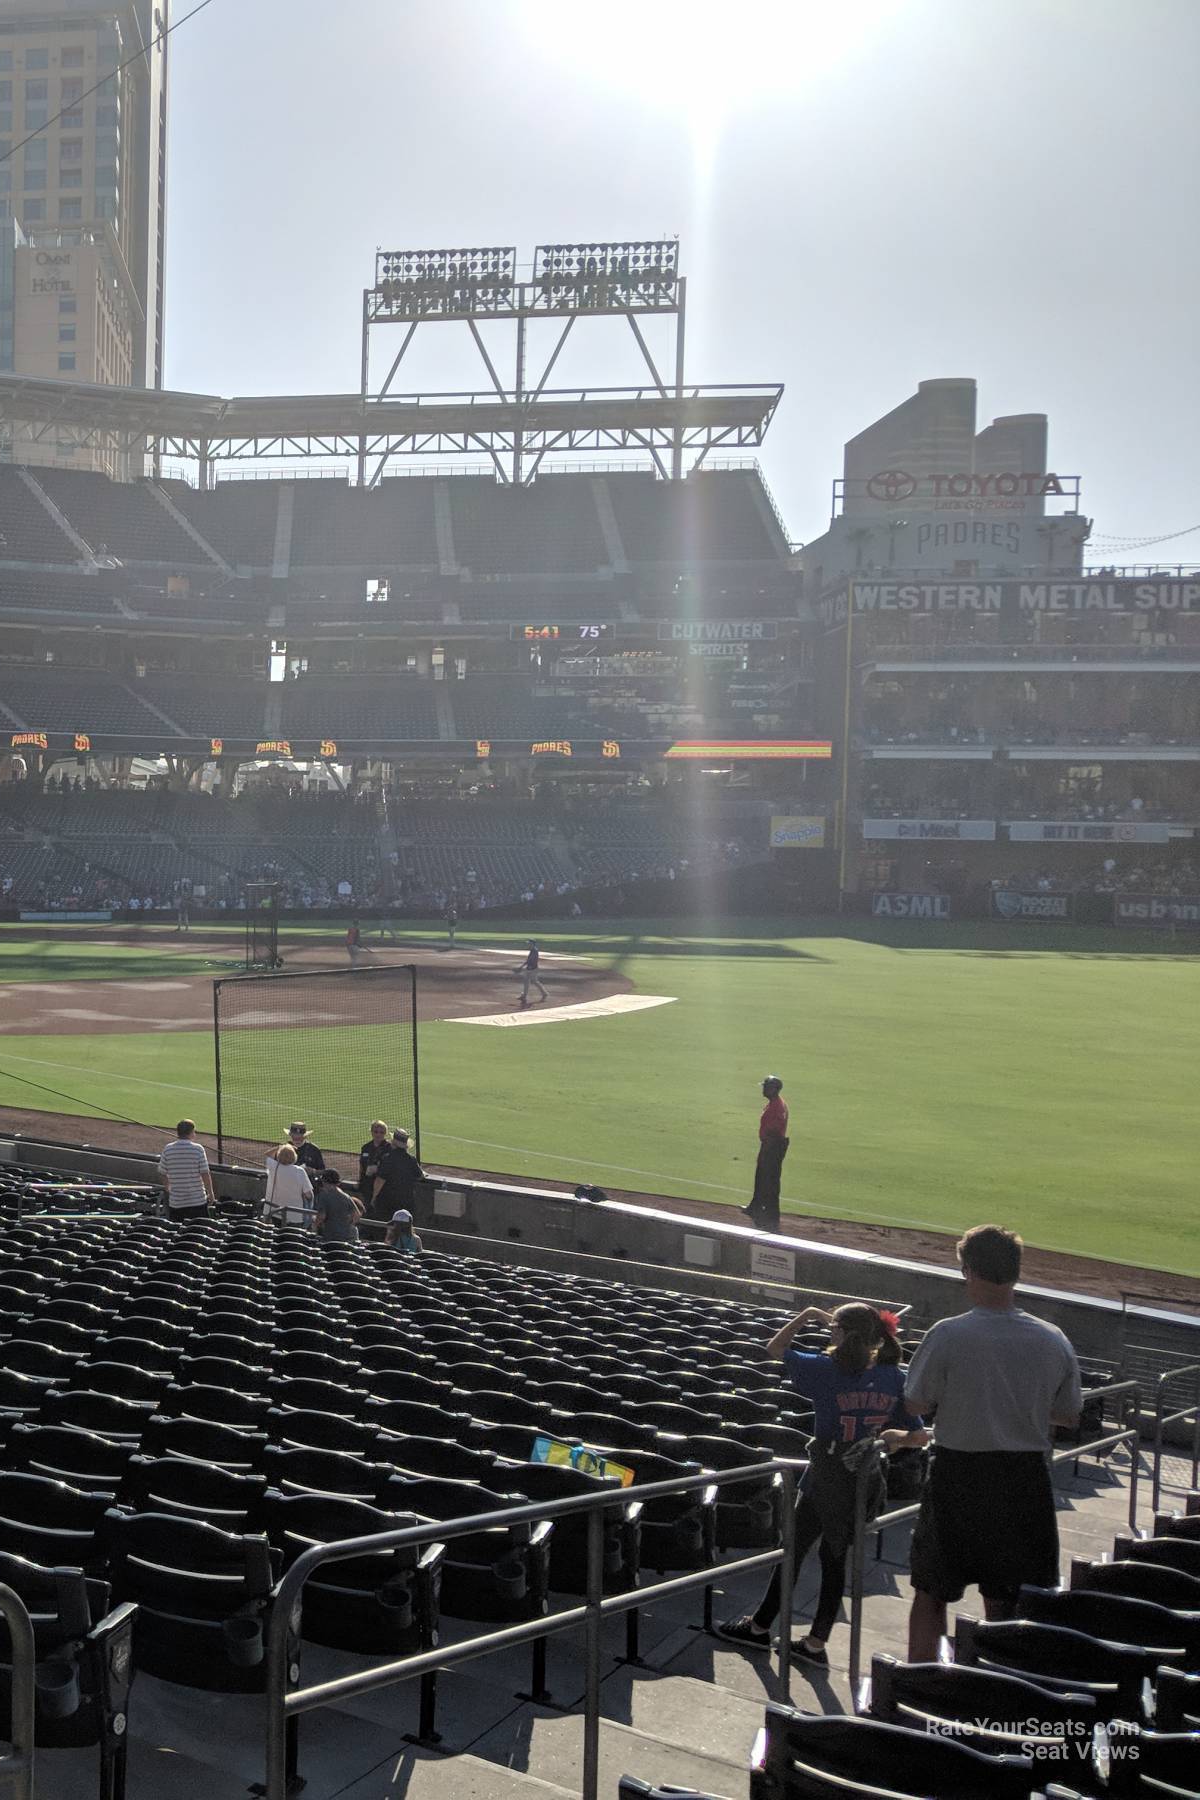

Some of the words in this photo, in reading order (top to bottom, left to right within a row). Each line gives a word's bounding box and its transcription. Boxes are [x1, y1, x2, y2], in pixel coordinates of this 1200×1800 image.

[31, 278, 73, 292] HOTEL
[928, 472, 1064, 497] TOYOTA
[917, 522, 1020, 555] PADRES
[855, 585, 1002, 610] WESTERN
[1019, 585, 1124, 610] METAL
[524, 626, 560, 639] 5:41
[672, 623, 763, 639] CUTWATER
[689, 643, 744, 655] SPIRITS
[11, 733, 48, 749] PADRES
[256, 741, 291, 755] PADRES
[531, 741, 572, 756] PADRES
[774, 824, 822, 844] Snapple
[875, 895, 946, 918] ASML
